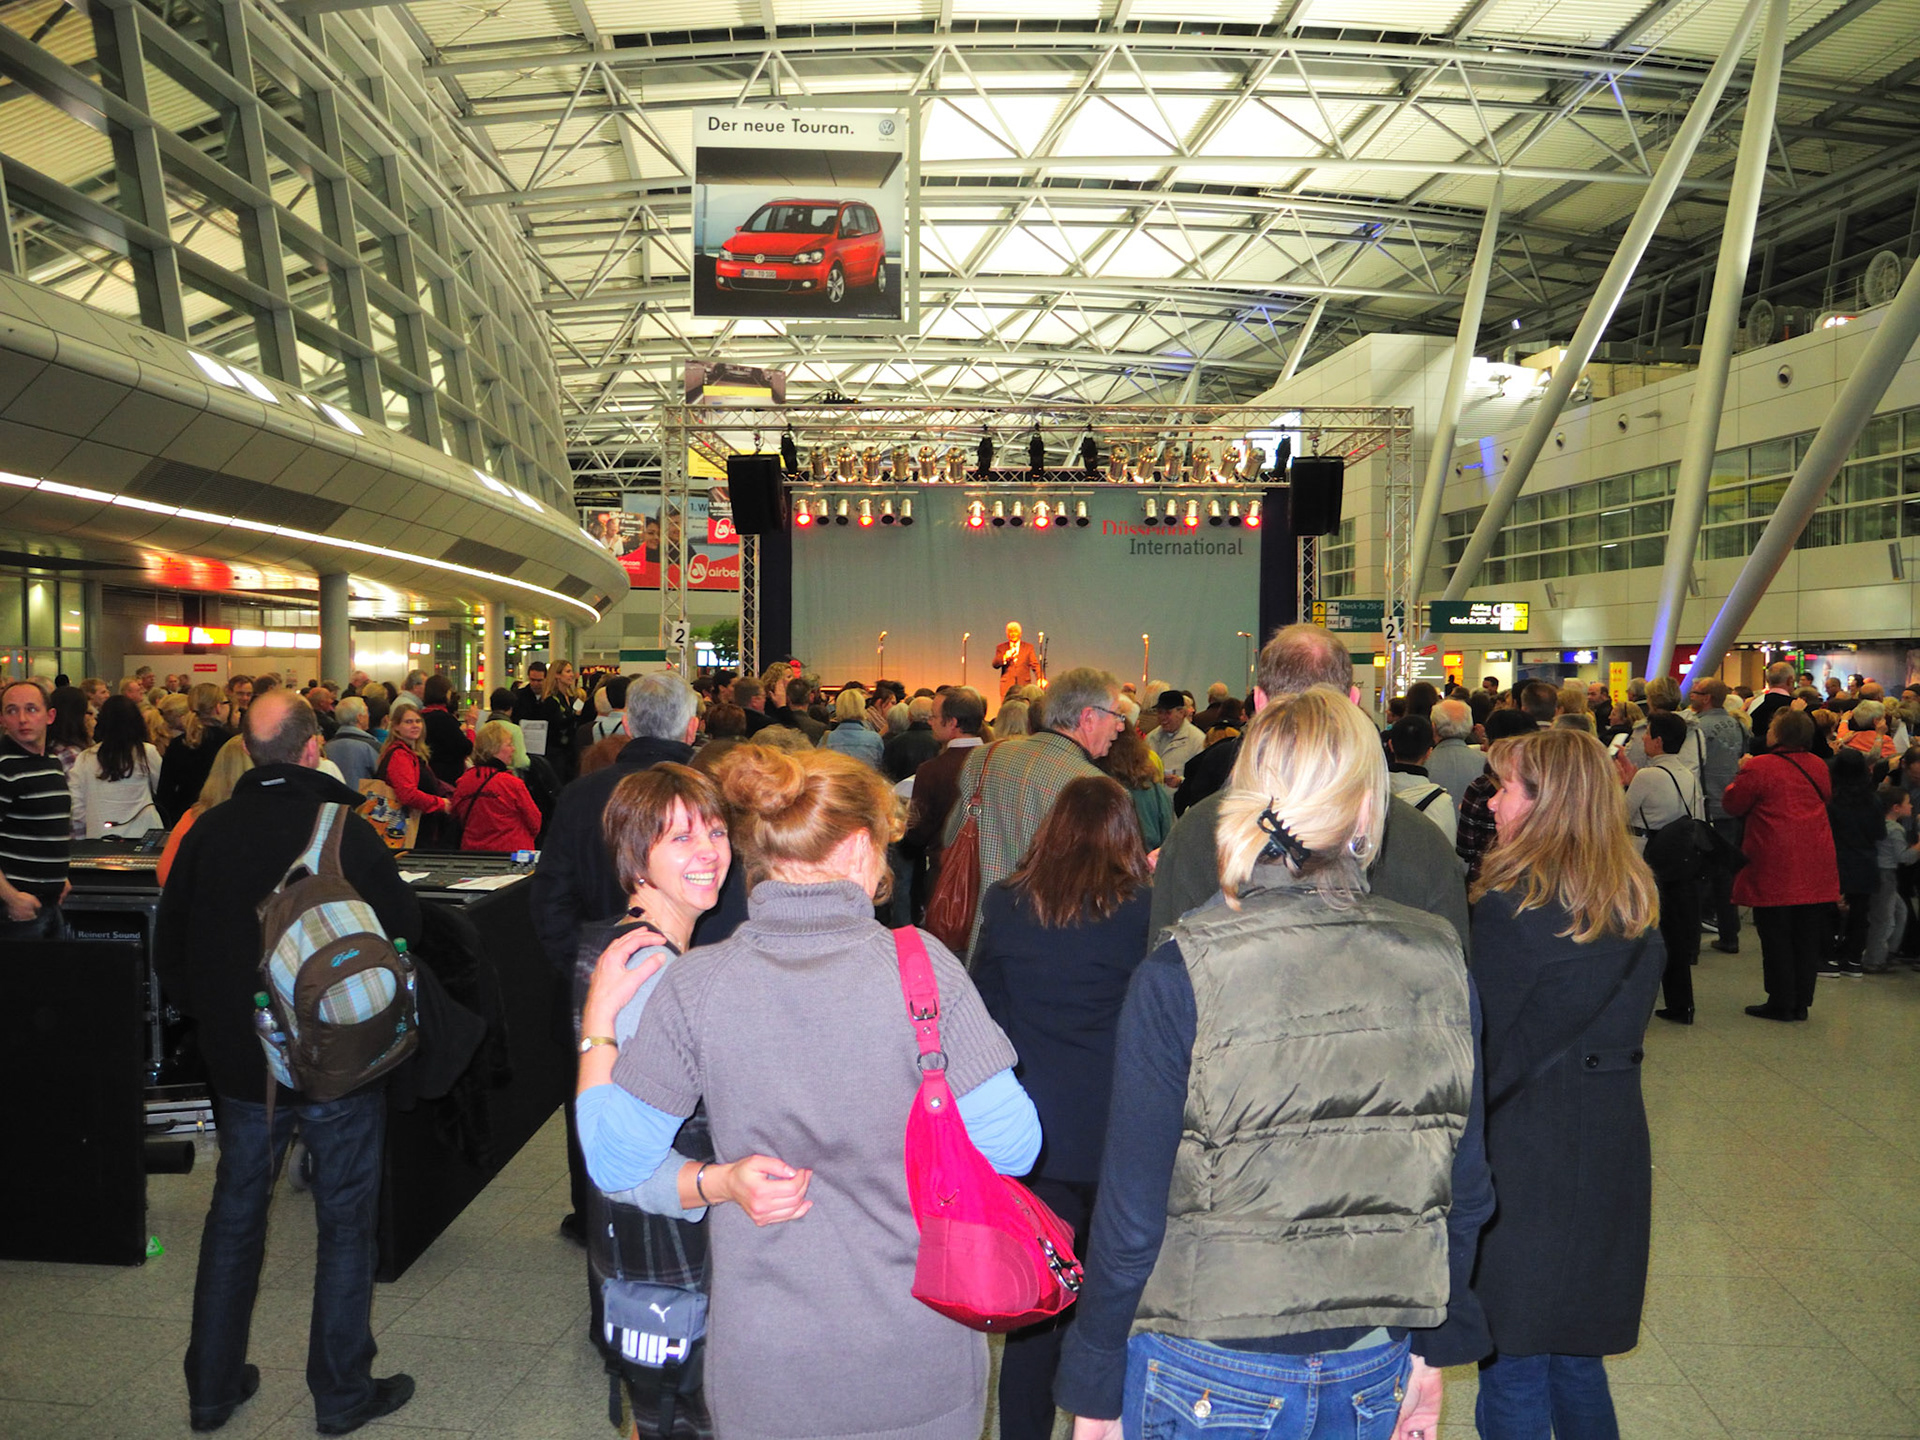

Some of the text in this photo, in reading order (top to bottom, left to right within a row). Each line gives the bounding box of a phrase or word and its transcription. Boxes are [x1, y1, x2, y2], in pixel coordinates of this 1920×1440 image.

[708, 116, 854, 135] Der neue Touran.
[1130, 537, 1243, 555] International
[675, 628, 685, 644] 2
[1385, 623, 1396, 639] 2
[78, 930, 141, 939] Reinert Sound
